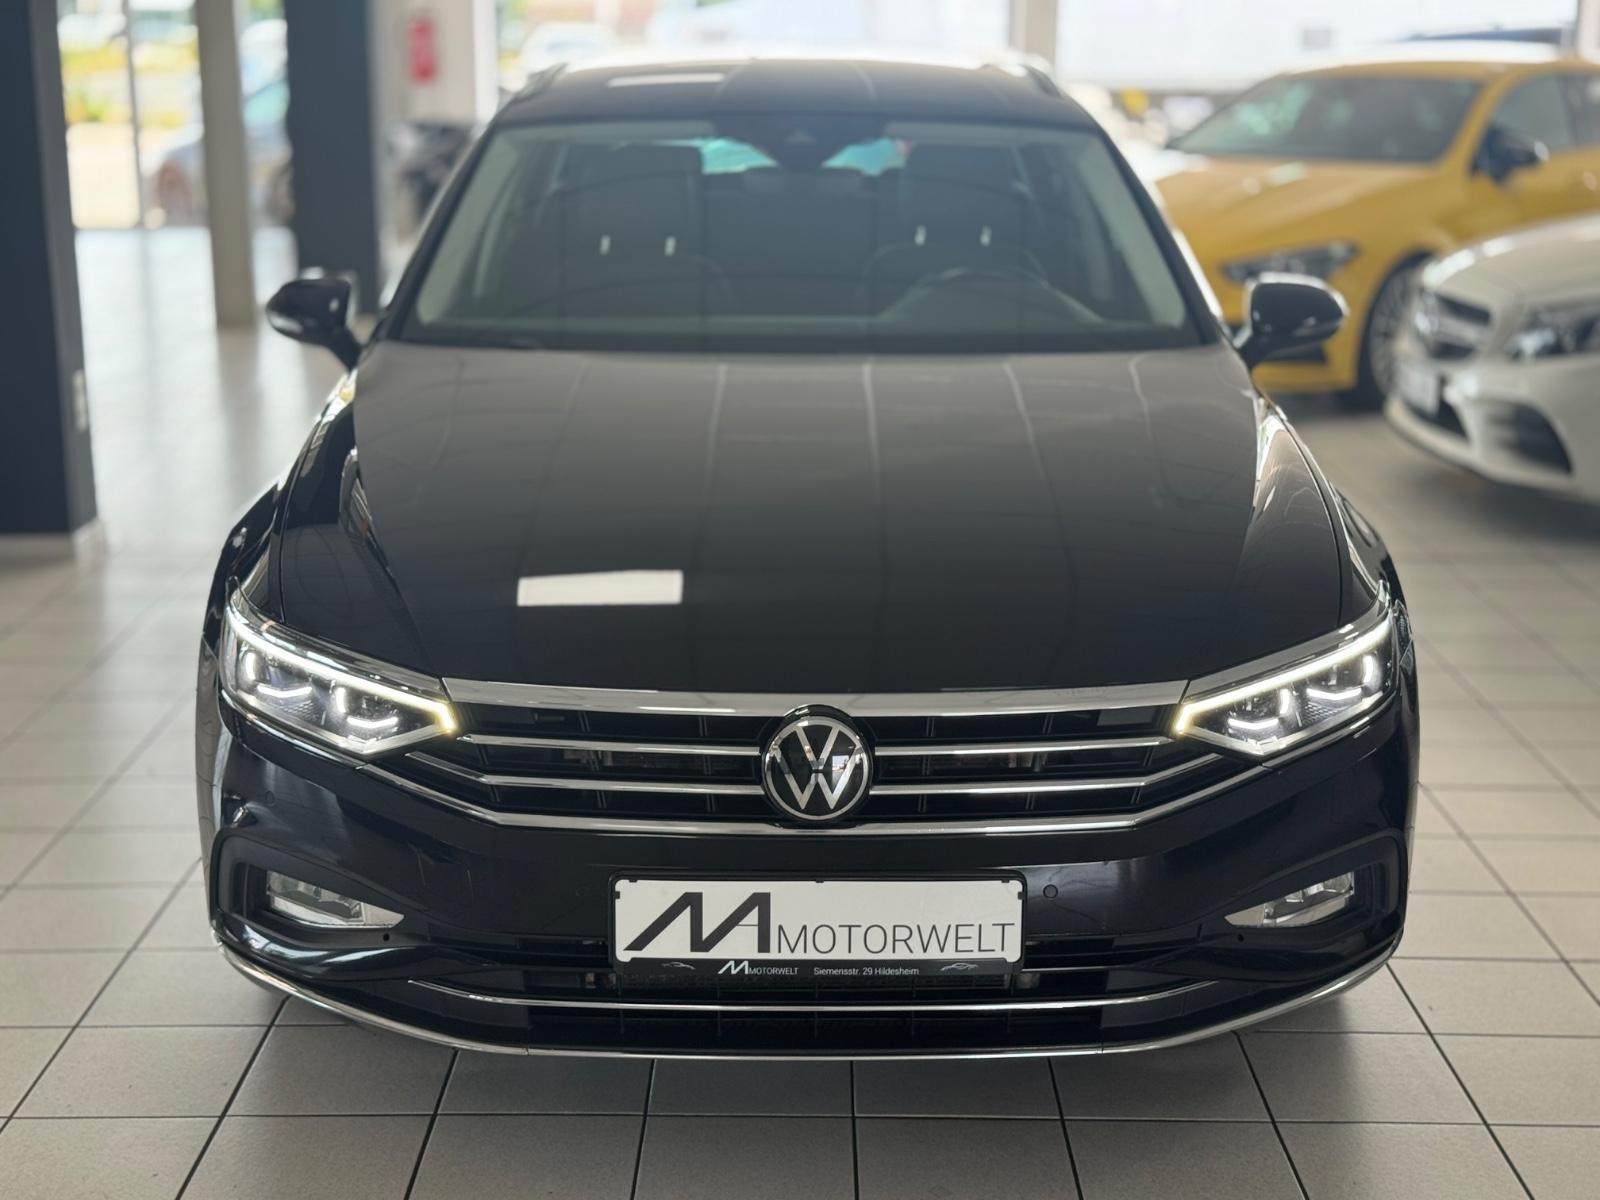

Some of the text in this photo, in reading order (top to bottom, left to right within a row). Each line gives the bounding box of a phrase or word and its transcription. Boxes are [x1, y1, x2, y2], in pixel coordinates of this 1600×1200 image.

[777, 923, 1015, 954] MOTORWELT
[749, 967, 799, 975] MOTORWELT
[813, 966, 920, 976] Siemensstr. 29 Hildesheim
